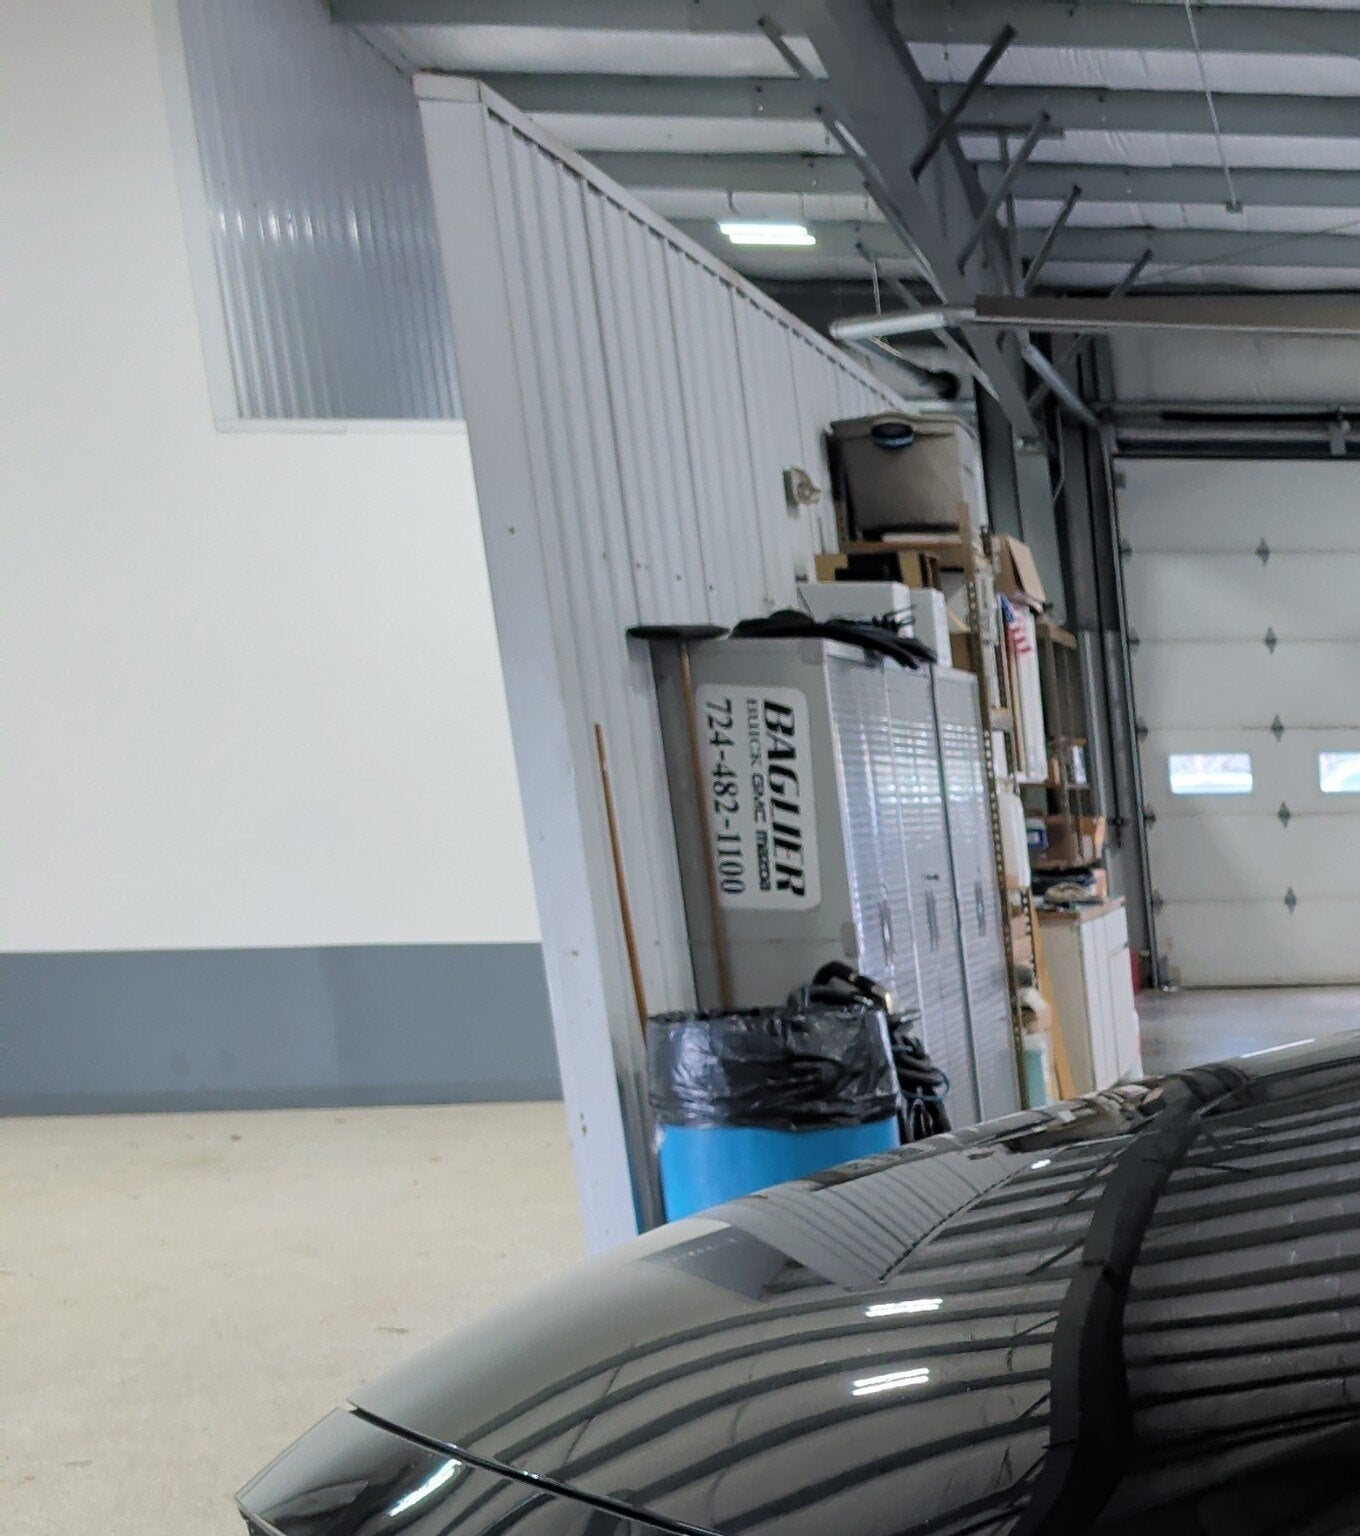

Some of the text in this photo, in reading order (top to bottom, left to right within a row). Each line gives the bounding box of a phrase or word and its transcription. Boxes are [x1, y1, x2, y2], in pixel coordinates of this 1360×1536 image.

[706, 697, 747, 896] 724-482-1100
[751, 772, 767, 824] GMC
[756, 829, 772, 891] mazda
[764, 700, 806, 897] BAGLIER
